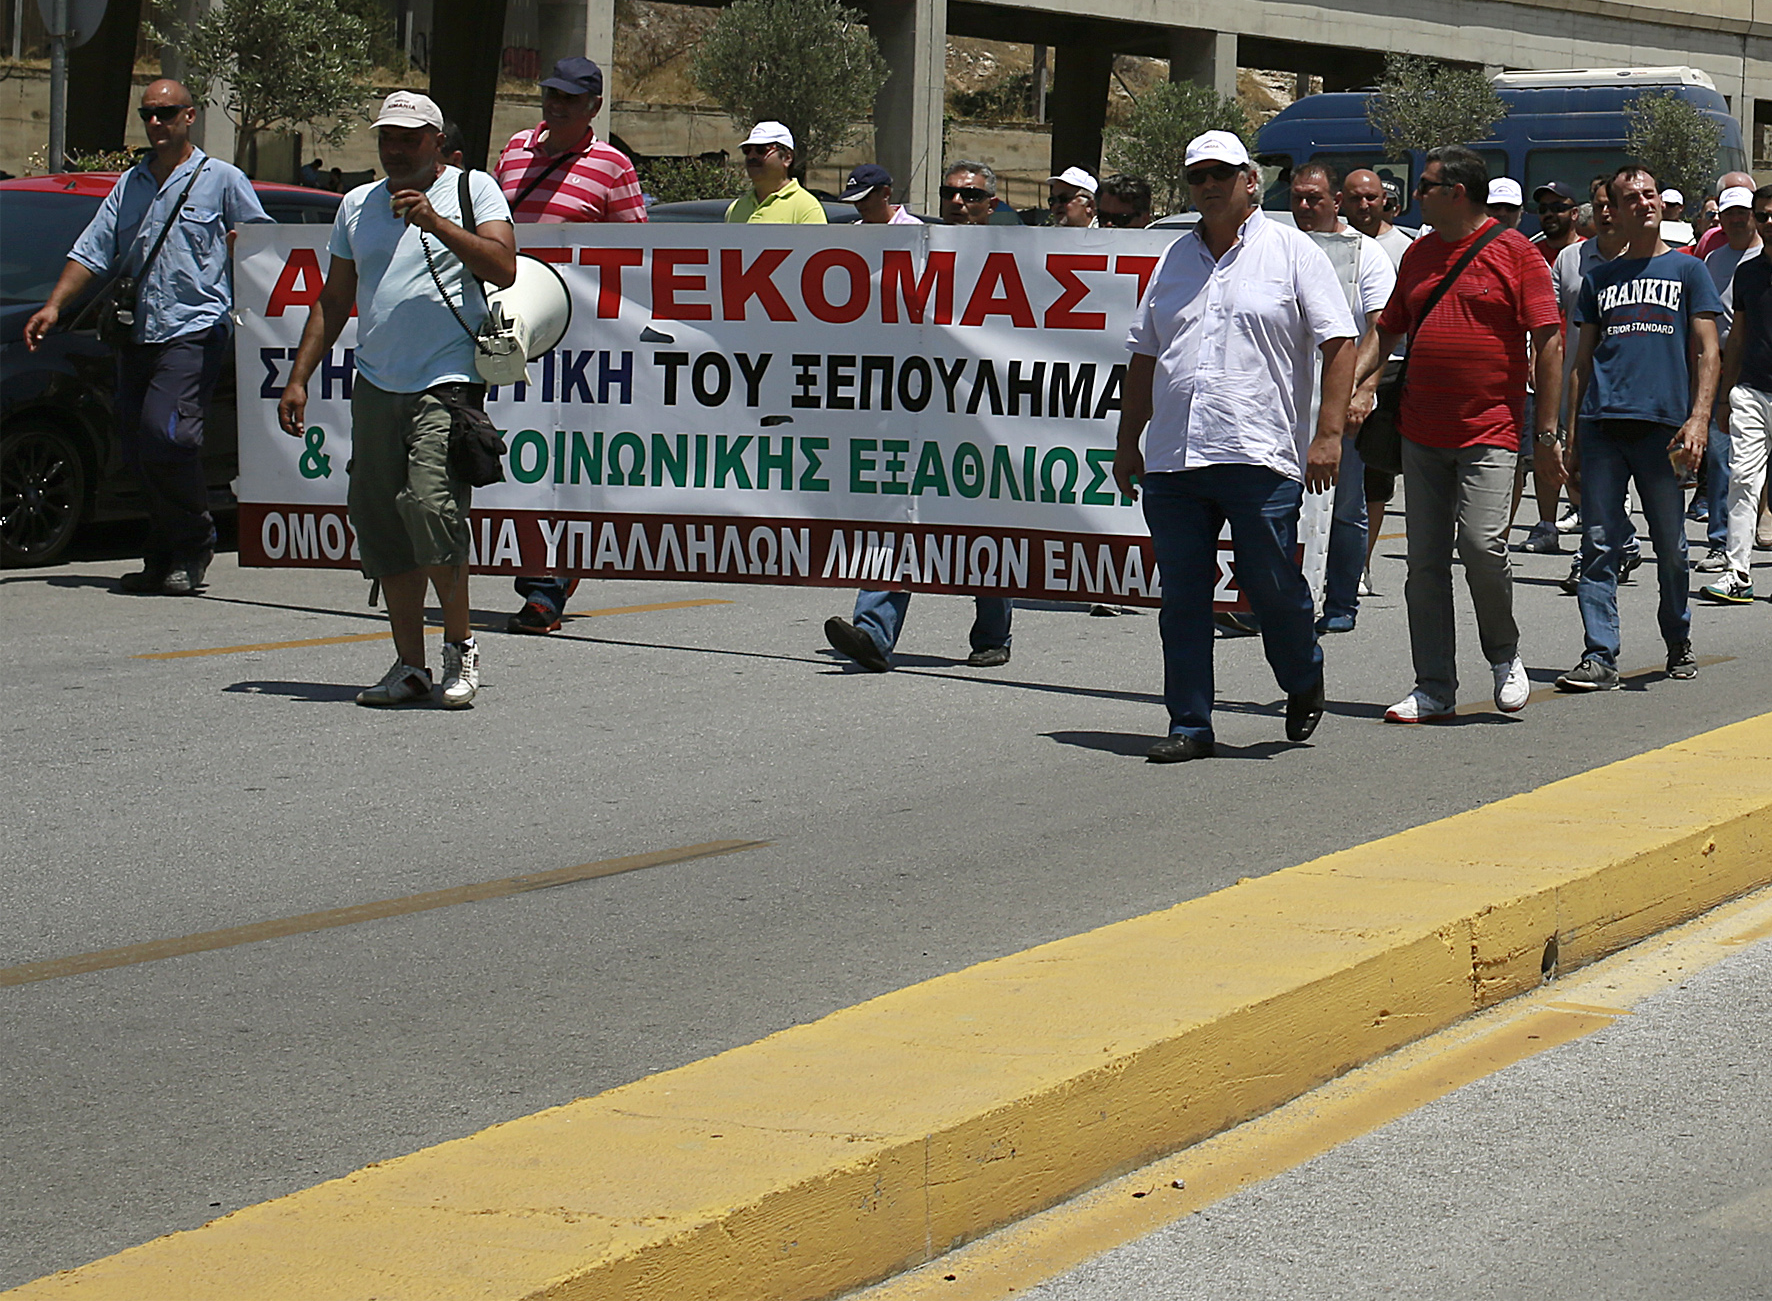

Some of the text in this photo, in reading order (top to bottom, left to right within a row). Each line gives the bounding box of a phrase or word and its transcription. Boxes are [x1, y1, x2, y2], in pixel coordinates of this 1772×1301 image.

[1631, 322, 1674, 335] STANDARD
[654, 351, 772, 408] ΤΟΥ
[790, 353, 1129, 420] ΞΕΠΟΥΛΗΜΑ
[299, 425, 332, 480] &
[497, 429, 1139, 507] ΟΙΝΩΝΙΚΗΣ ΕΞΑΘΛΙΩΣ
[537, 518, 811, 578] ΥΠΑΛΛΗΛΩΝ
[822, 526, 1029, 590] ΛΙΜΑΝΙΩΝ
